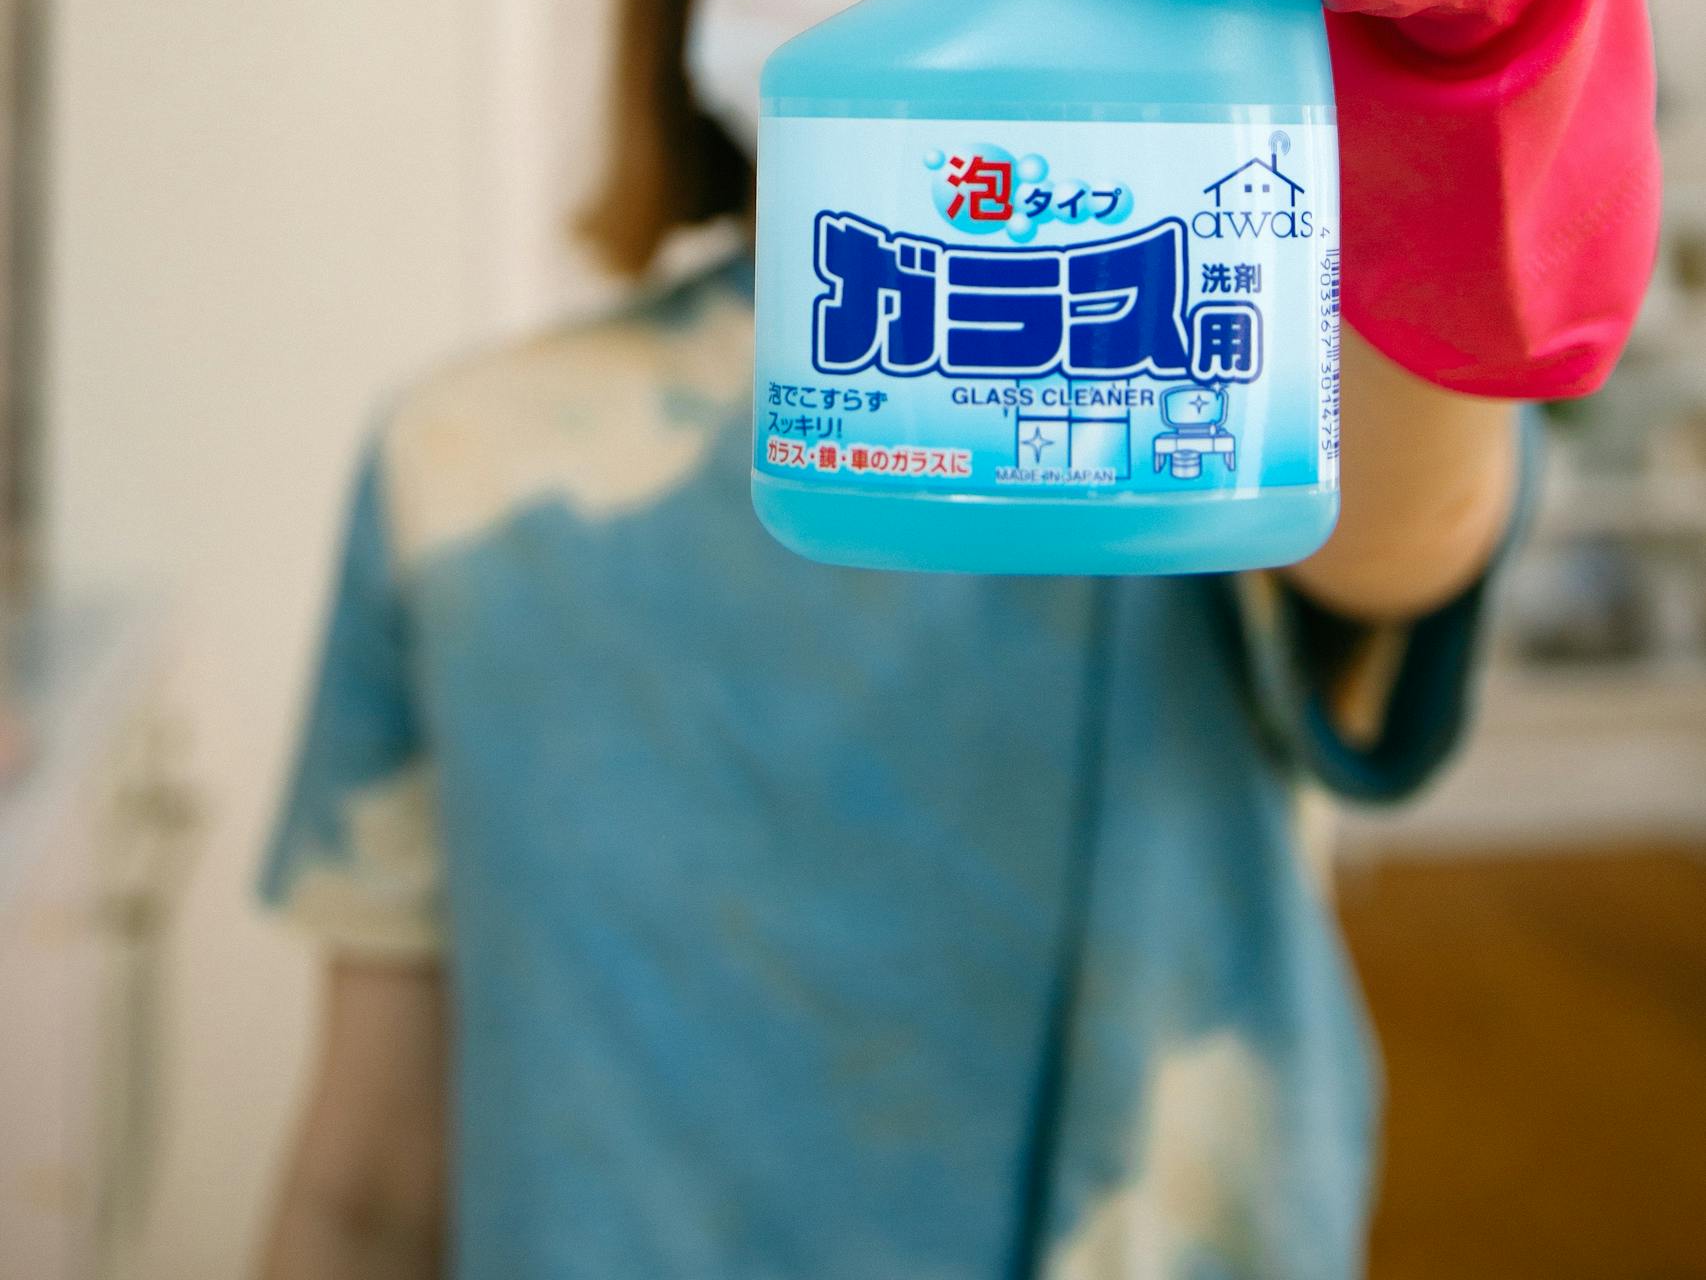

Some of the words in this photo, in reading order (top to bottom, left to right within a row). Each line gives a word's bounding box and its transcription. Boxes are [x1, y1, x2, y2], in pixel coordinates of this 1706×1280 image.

[1191, 210, 1314, 239] awas
[1320, 227, 1331, 239] 4
[1201, 263, 1262, 294] 洗剤
[768, 381, 888, 412] 泡でこすらず
[952, 386, 1034, 406] GLASS
[1042, 387, 1155, 406] CLEANER
[768, 440, 970, 474] ガラス・鏡・車のガラスに
[996, 469, 1036, 481] MADE
[1041, 470, 1060, 481] IN
[1064, 470, 1113, 482] JAPAN
